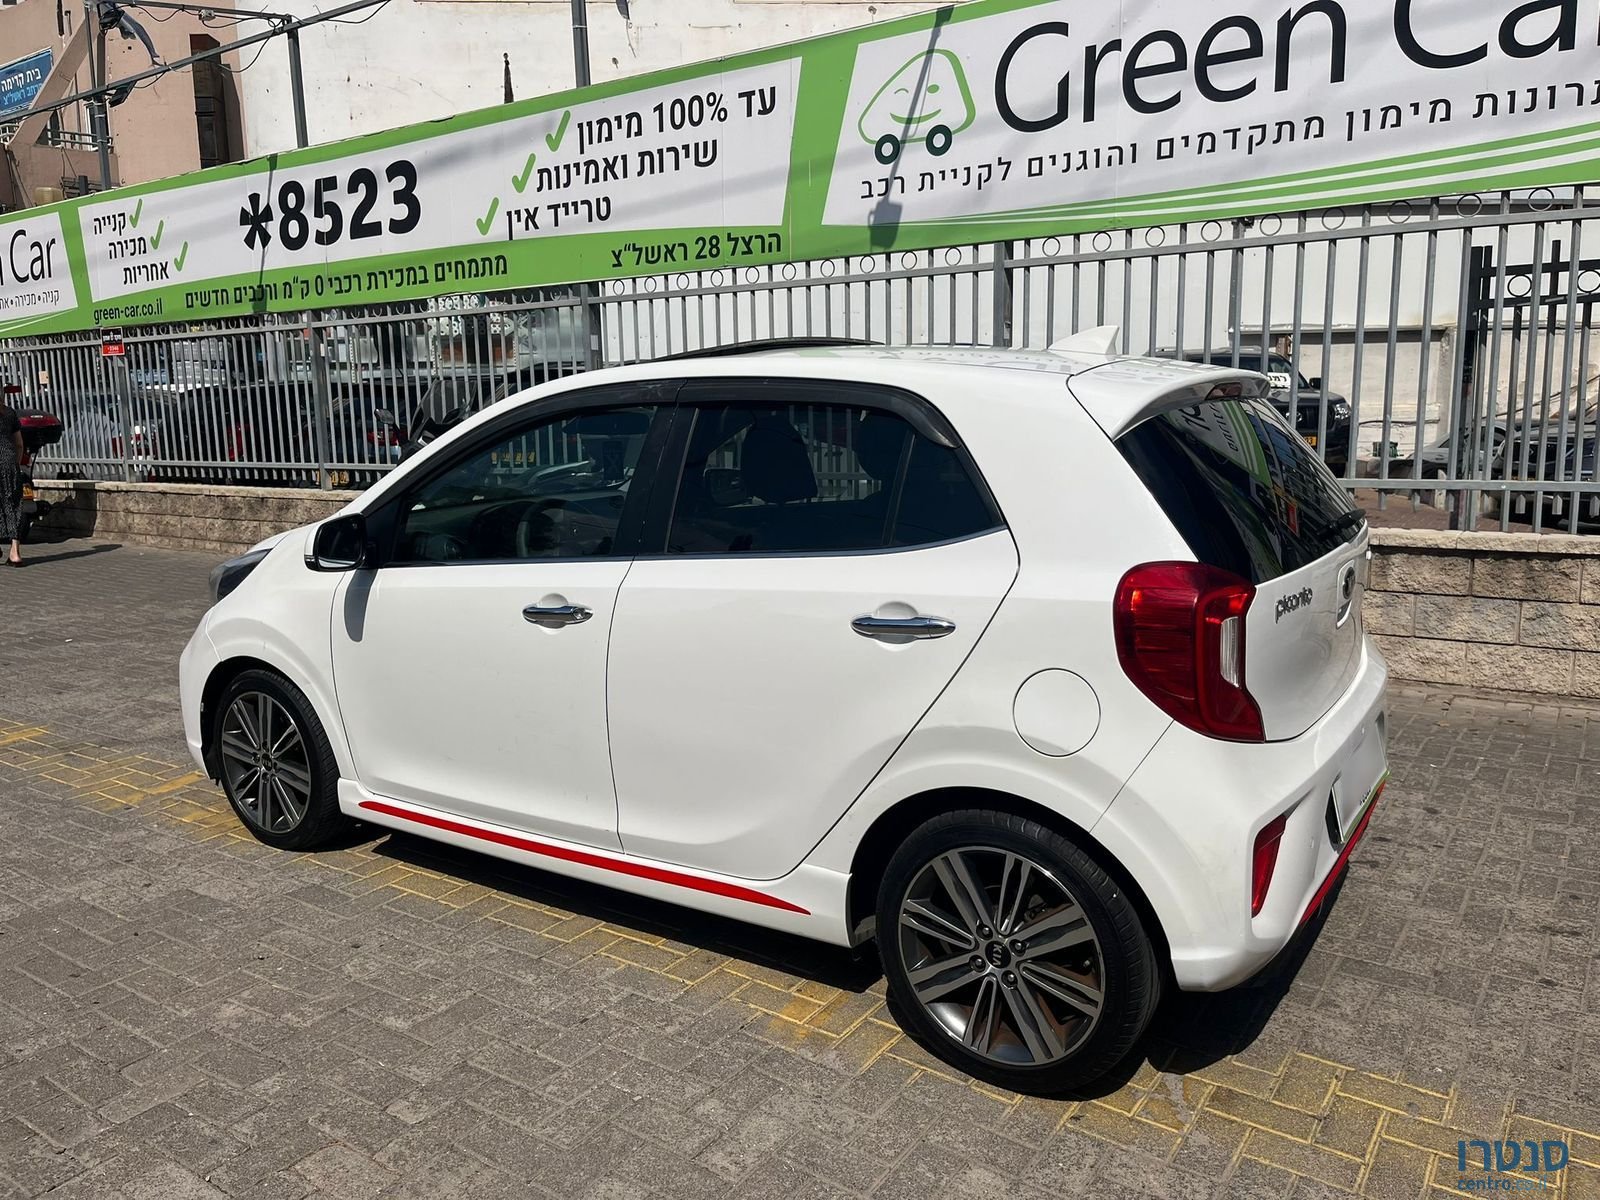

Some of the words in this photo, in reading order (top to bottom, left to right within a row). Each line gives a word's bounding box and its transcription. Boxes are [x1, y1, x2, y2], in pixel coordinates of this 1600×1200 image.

[26, 68, 41, 83] בית
[994, 0, 1347, 133] Green
[1393, 0, 1600, 69] Ca
[1, 72, 25, 92] קדימה
[653, 92, 728, 133] 100%
[738, 85, 777, 118] עד
[577, 111, 643, 155] מימון
[1347, 98, 1451, 142] מימון
[1157, 115, 1325, 161] מתקדמים
[637, 138, 718, 177] שירות
[1027, 142, 1137, 178] והוגנים
[536, 153, 628, 192] ואמינות
[917, 157, 1013, 192] לקניית
[860, 175, 905, 199] רכב
[93, 211, 127, 236] קנייה
[506, 205, 540, 241] אין
[547, 196, 612, 228] טרייד
[10, 229, 56, 283] Car
[108, 237, 147, 260] מכירה
[694, 235, 721, 260] 28
[727, 232, 782, 257] הרצל
[123, 260, 169, 286] אחריות
[367, 267, 429, 292] במכירת
[435, 254, 508, 283] מתמחים
[43, 290, 59, 306] קניה
[185, 286, 229, 310] חדשים
[234, 282, 279, 304] ורכבים
[328, 274, 362, 296] רכבי
[15, 293, 36, 308] מכירה
[93, 299, 163, 325] green-car.co.il
[1275, 587, 1313, 624] picanto
